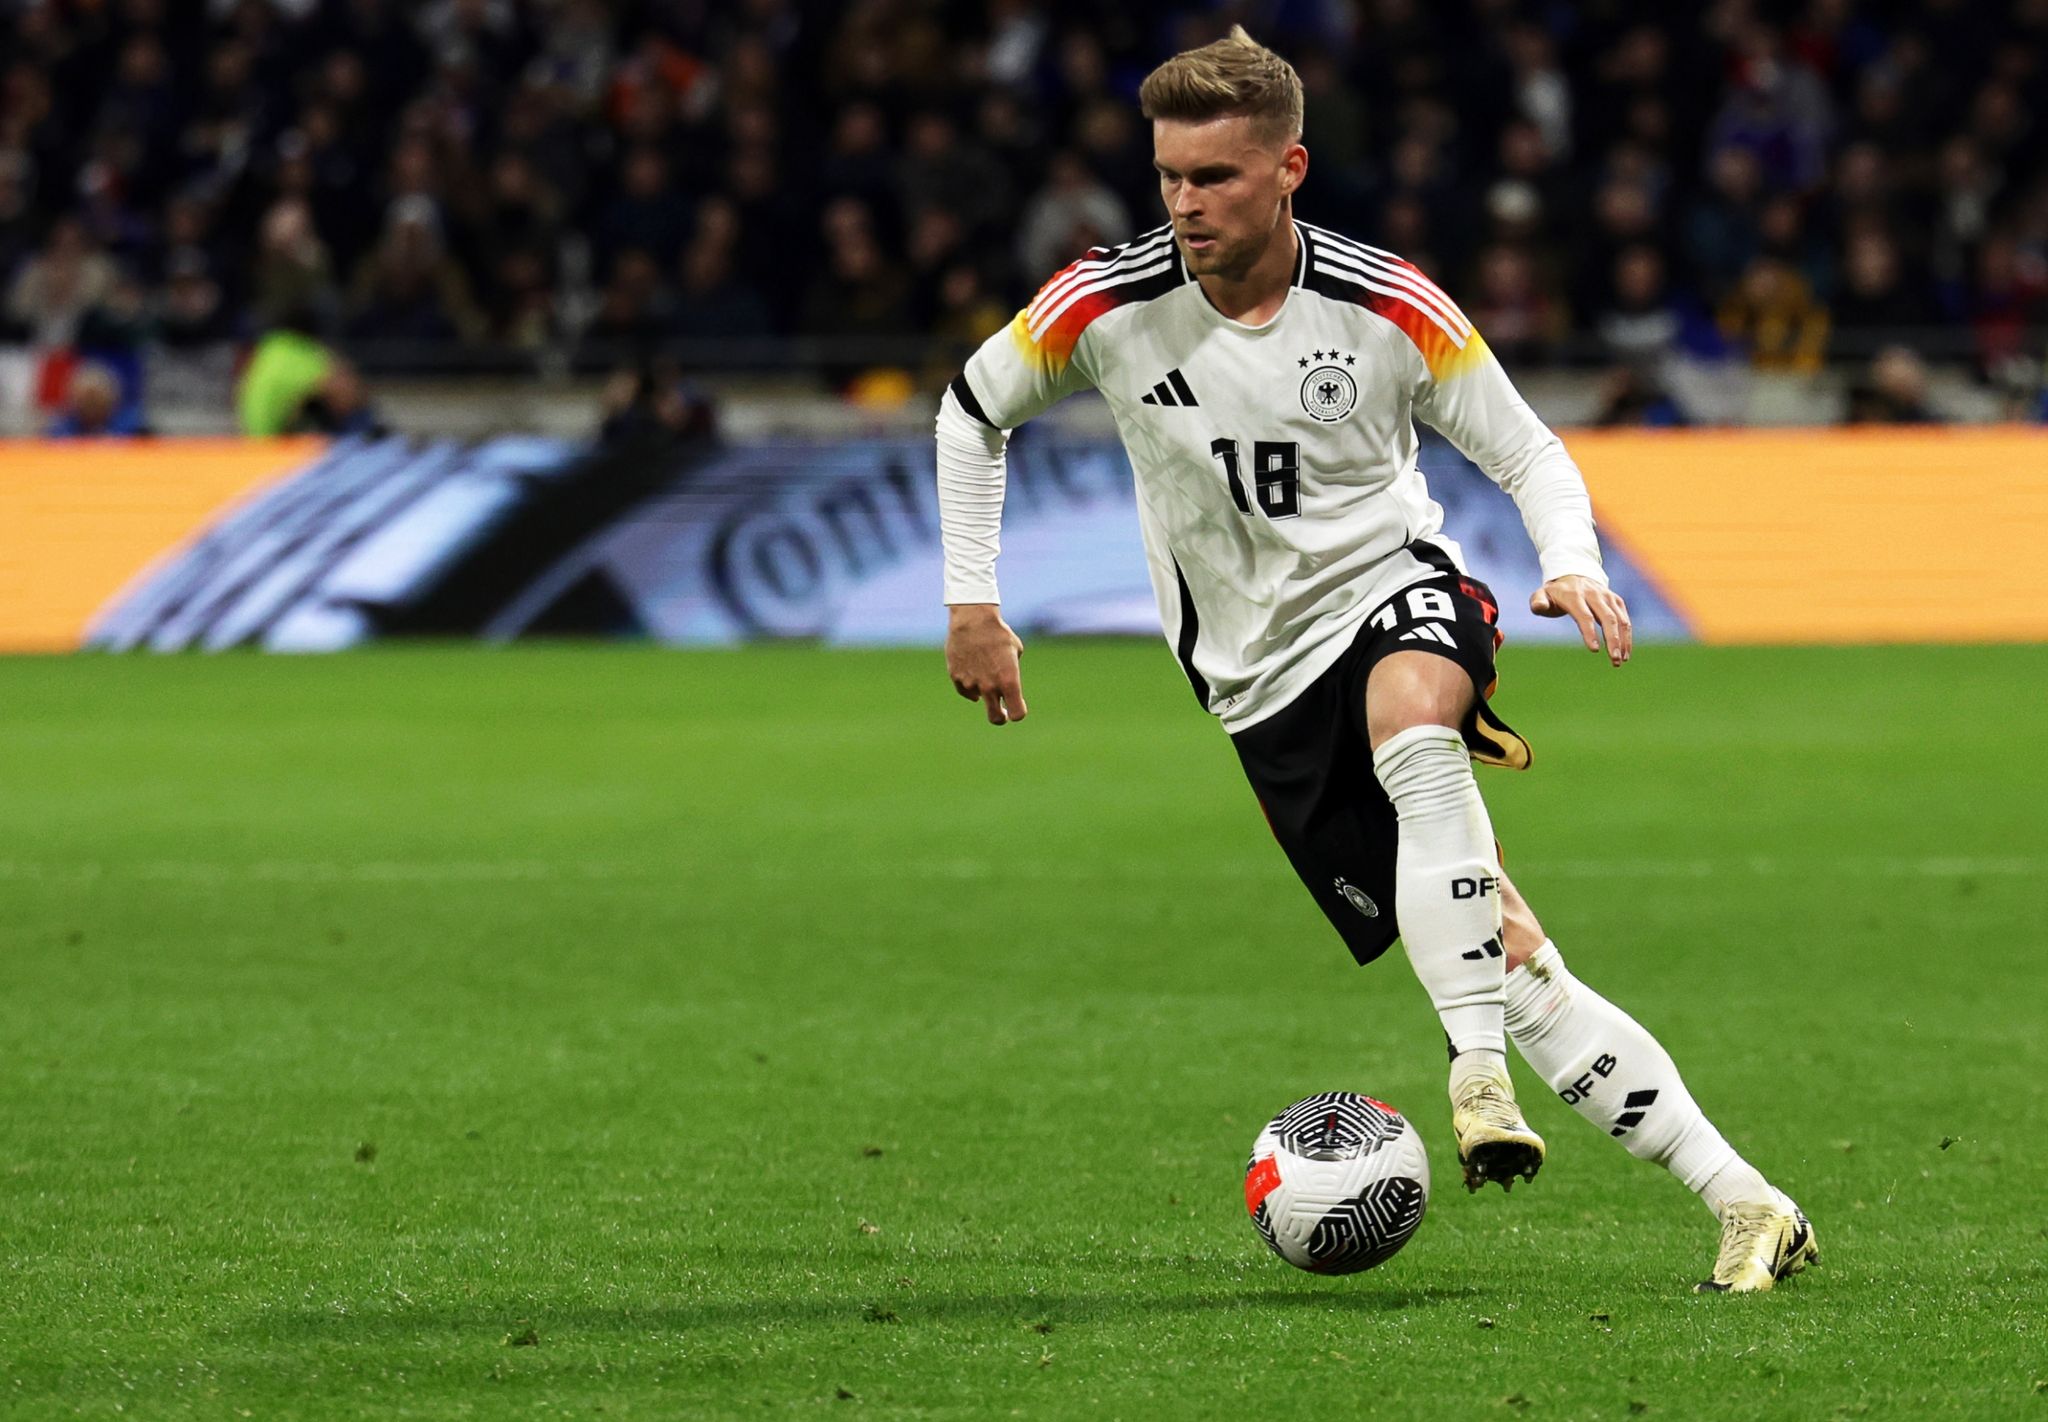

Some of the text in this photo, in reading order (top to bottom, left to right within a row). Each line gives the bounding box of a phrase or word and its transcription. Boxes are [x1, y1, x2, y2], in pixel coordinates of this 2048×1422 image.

[1210, 437, 1301, 521] 18
[1370, 587, 1457, 632] 18
[1559, 1053, 1617, 1106] DFB
